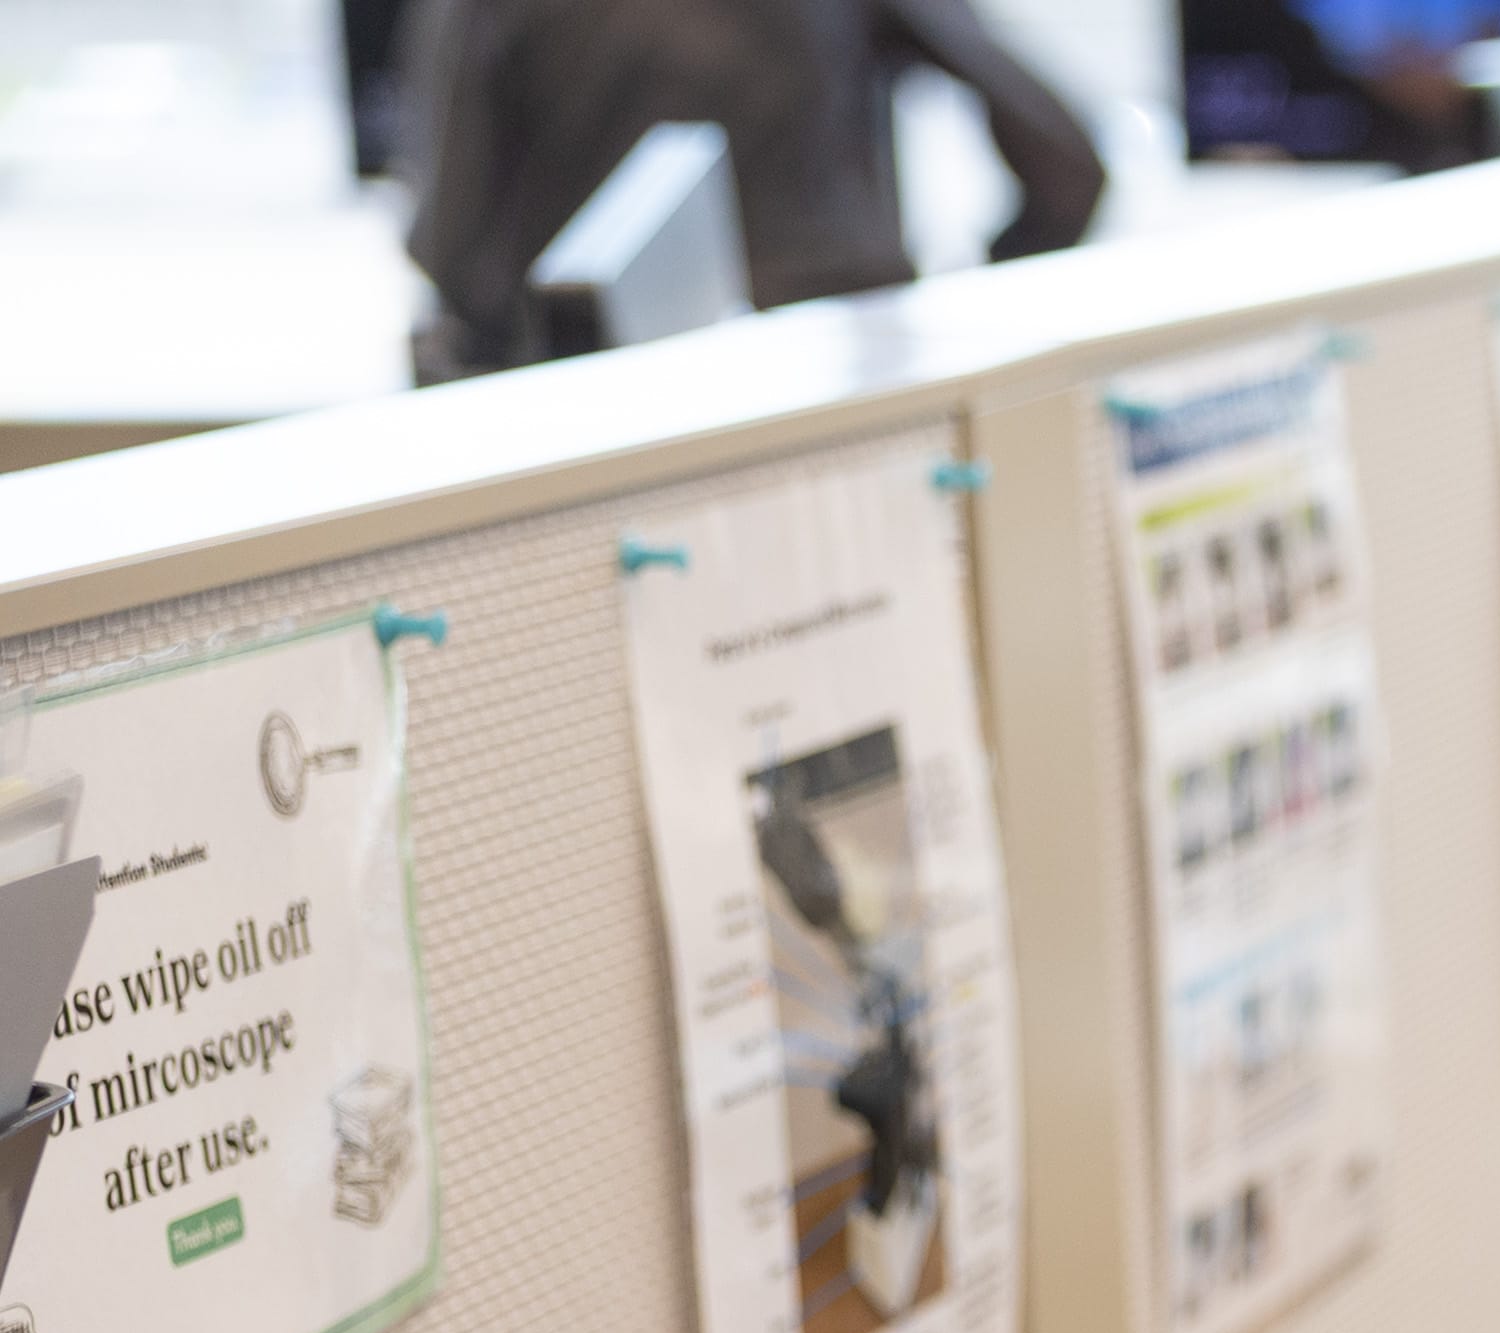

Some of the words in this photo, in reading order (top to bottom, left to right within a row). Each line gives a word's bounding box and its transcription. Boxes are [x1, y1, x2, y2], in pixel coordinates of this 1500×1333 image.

[97, 859, 149, 893] ttention
[122, 947, 211, 1014] wipe
[218, 916, 262, 984] oil
[268, 898, 313, 965] off
[91, 1008, 295, 1123] mircoscope
[104, 1141, 193, 1212] after
[201, 1112, 270, 1174] use.
[173, 1215, 213, 1254] Thank
